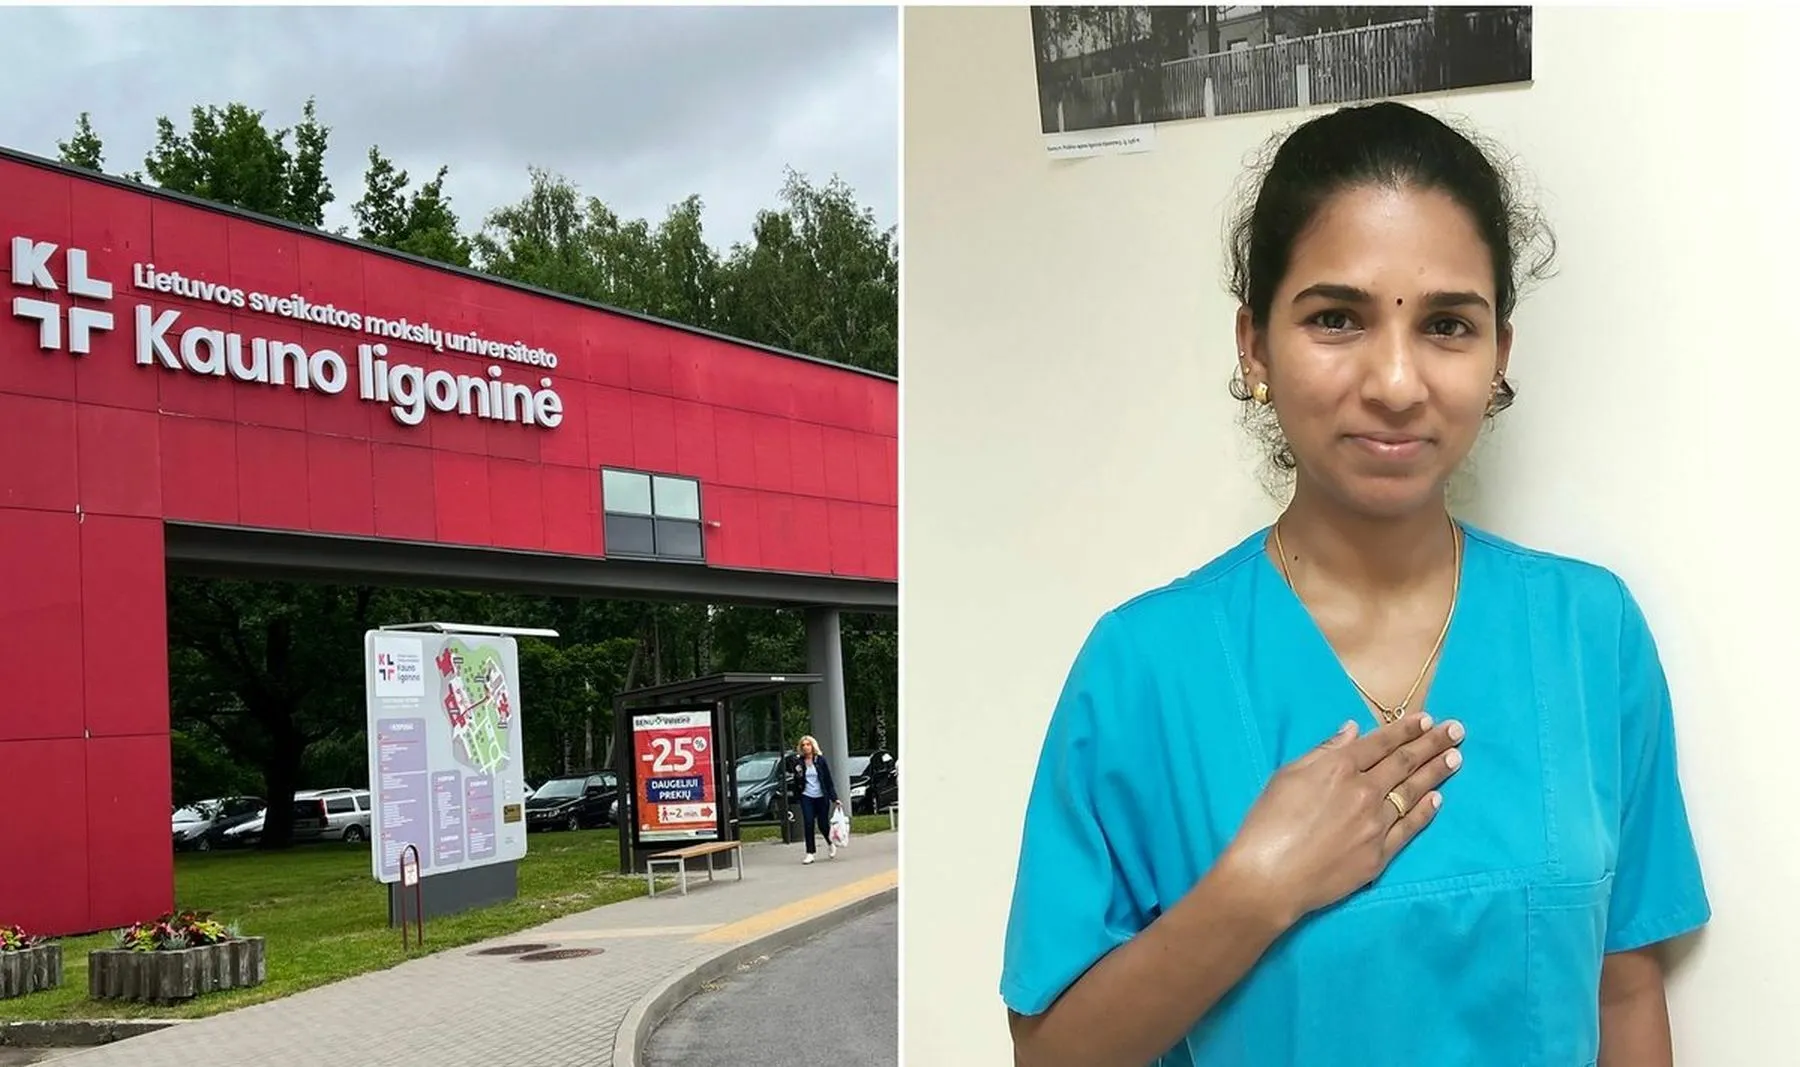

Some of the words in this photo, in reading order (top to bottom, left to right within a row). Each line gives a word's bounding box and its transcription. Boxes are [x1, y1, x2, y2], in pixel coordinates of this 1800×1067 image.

[134, 262, 246, 308] Lietuvos
[248, 291, 362, 331] sveikatos
[364, 313, 444, 352] mokslų
[445, 331, 558, 369] universiteto
[136, 304, 348, 394] Kauno
[358, 343, 564, 429] ligoninė
[651, 778, 698, 790] DAUGELIUI
[659, 790, 691, 801] PREKIŲ
